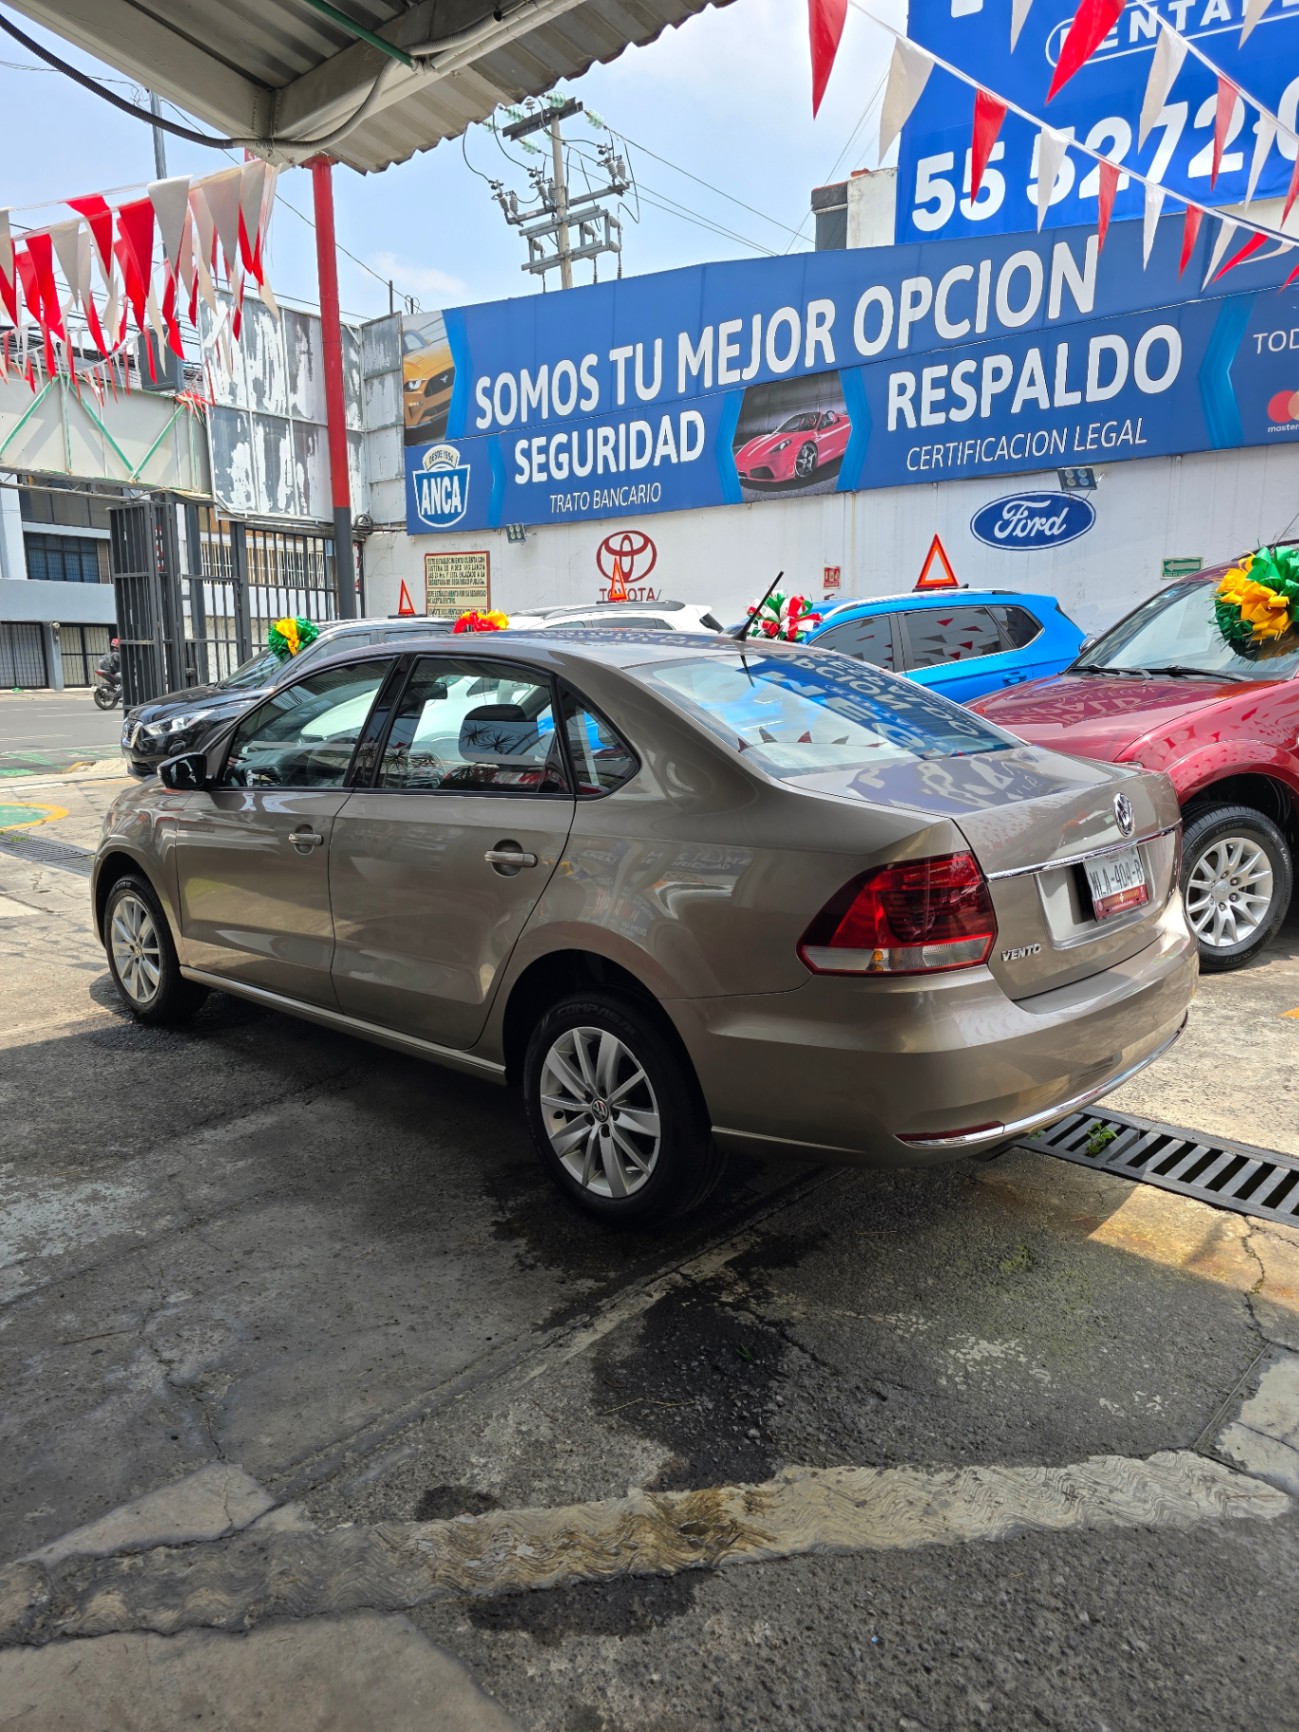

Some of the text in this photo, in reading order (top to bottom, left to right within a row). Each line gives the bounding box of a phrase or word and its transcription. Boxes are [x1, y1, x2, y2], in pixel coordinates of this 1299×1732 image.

[912, 142, 1005, 232] 55
[475, 235, 1100, 430] SOMOS TU MEJOR OPCION
[886, 324, 1182, 432] RESPALDO
[429, 450, 443, 464] DESDE
[514, 410, 705, 485] SEGURIDAD
[906, 417, 1147, 471] CERTIFICACION LEGAL
[421, 475, 462, 515] ANCA
[549, 482, 661, 514] TRATO BANCARIO
[994, 499, 1069, 539] Ford
[1000, 943, 1041, 961] VENTO
